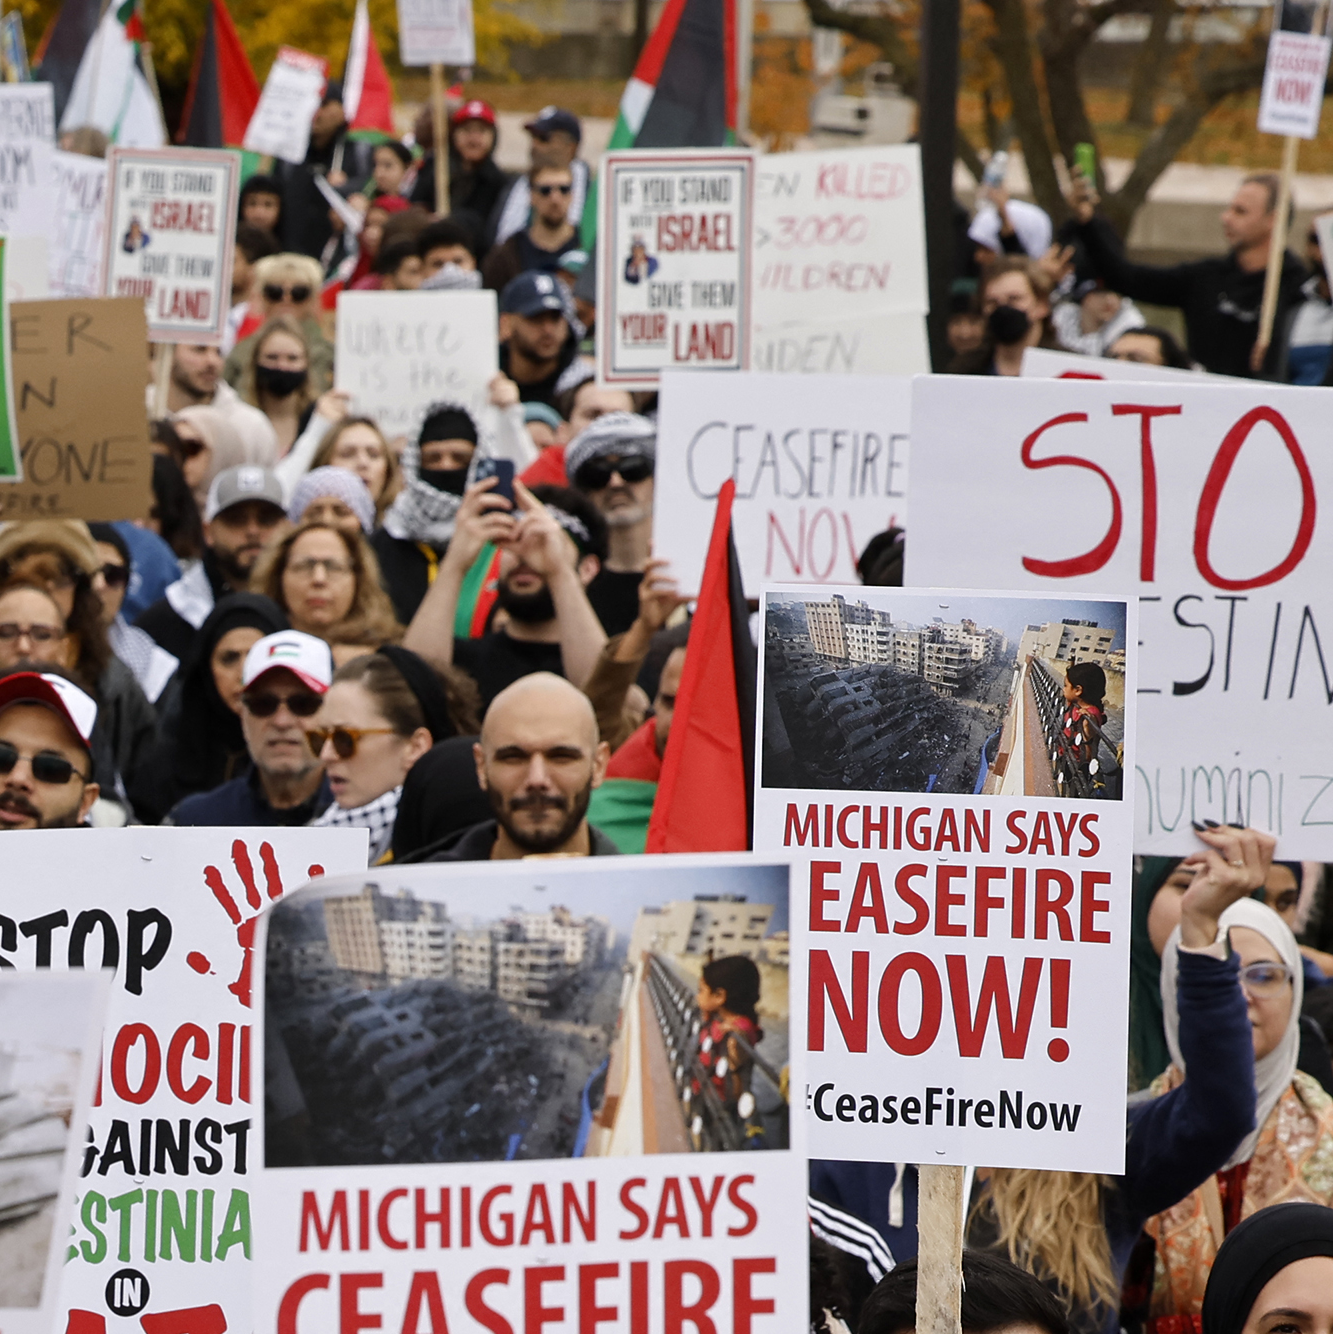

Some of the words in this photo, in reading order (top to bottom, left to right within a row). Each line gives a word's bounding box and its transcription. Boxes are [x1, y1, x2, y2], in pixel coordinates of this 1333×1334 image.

[621, 178, 636, 204] IF
[640, 176, 675, 204] YOU
[679, 173, 732, 203] STAND
[814, 160, 912, 201] KILLED
[150, 198, 217, 234] ISRAEL
[655, 211, 736, 252] ISRAEL
[158, 286, 211, 321] LAND
[647, 281, 684, 310] GIVE
[690, 279, 735, 309] THEM
[619, 312, 668, 341] YOUR
[673, 320, 735, 363] LAND
[685, 420, 911, 501] CEASEFIRE
[783, 802, 992, 855] MICHIGAN
[1005, 809, 1101, 858] SAYS
[808, 860, 1112, 945] EASEFIRE
[807, 948, 1071, 1064] NOW!
[300, 1180, 597, 1252] MICHIGAN
[619, 1173, 760, 1243] SAYS
[113, 1277, 141, 1308] IN
